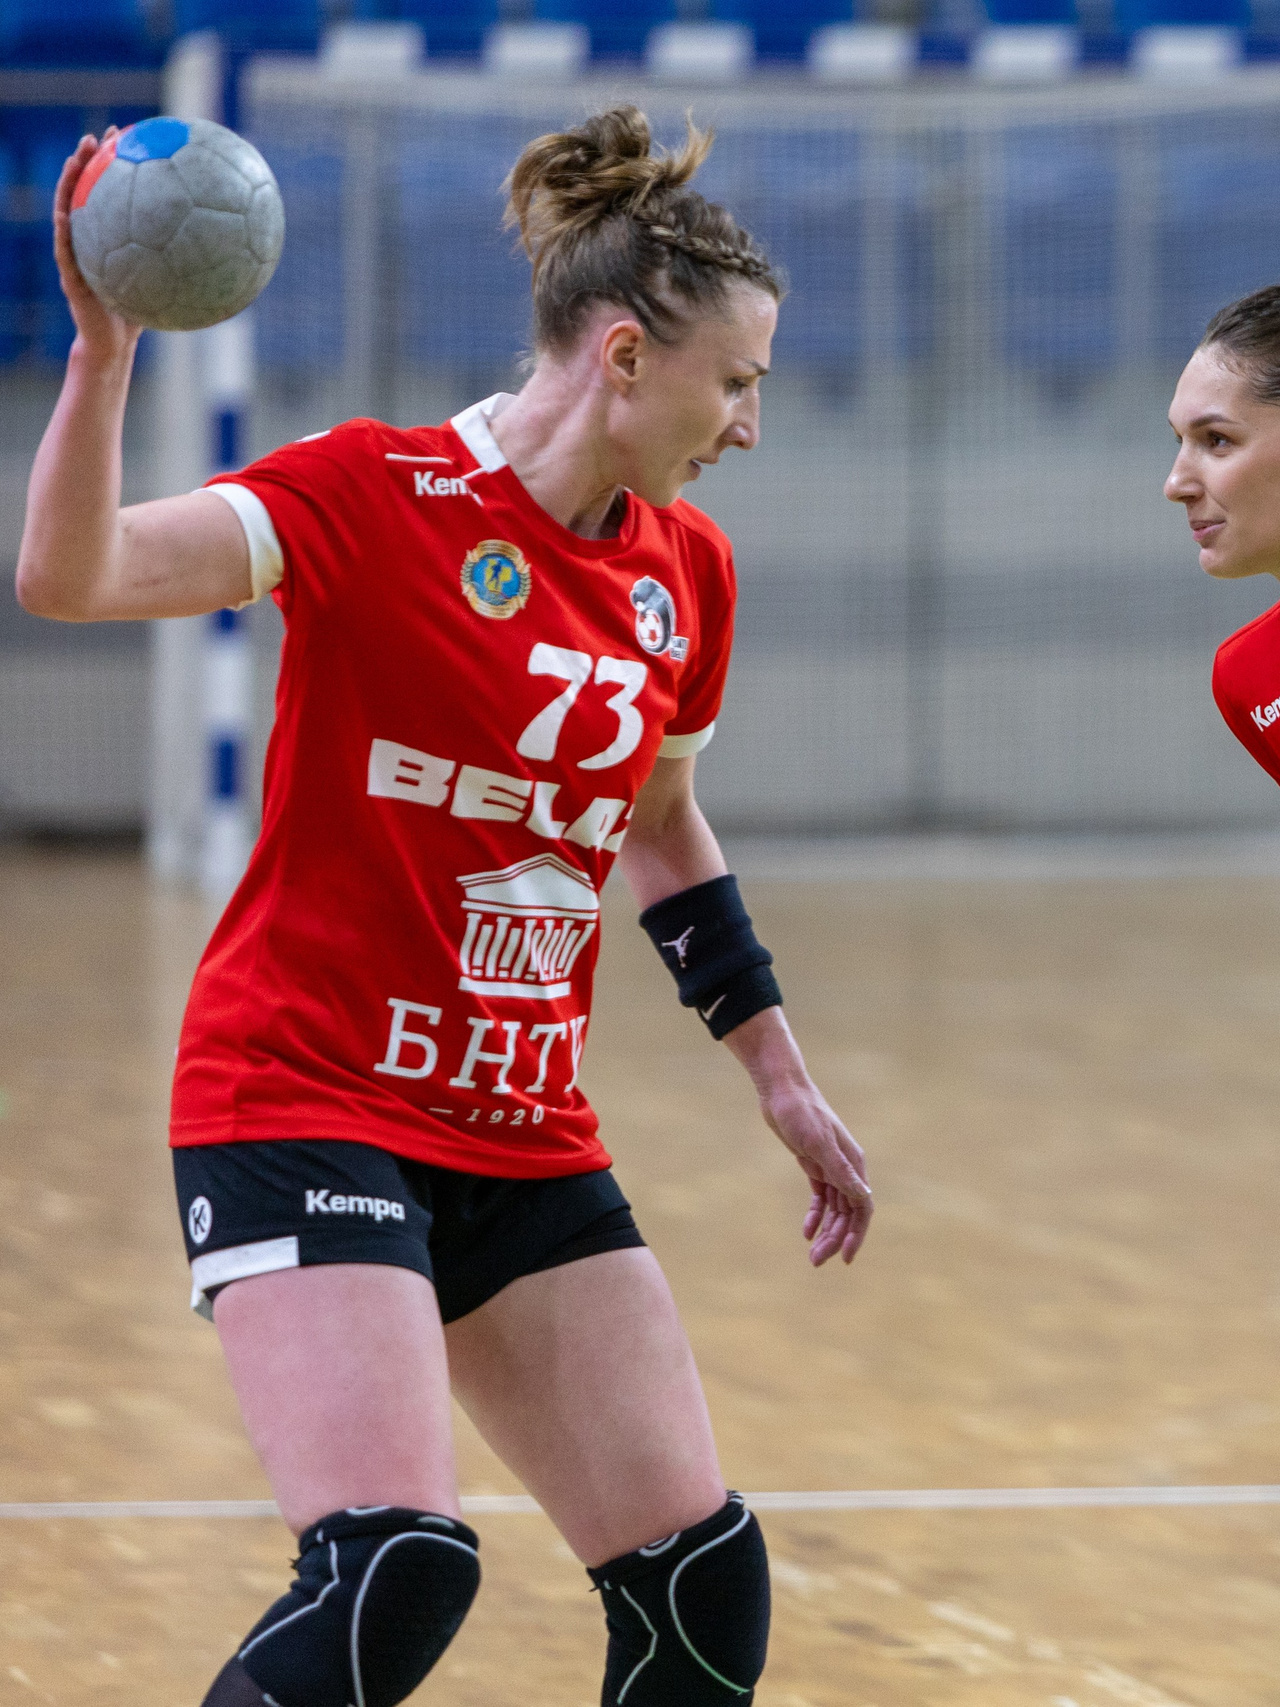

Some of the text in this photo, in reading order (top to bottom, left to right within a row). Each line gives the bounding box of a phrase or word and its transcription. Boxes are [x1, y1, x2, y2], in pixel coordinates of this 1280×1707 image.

[516, 642, 647, 770] 73
[366, 737, 635, 854] BELA
[304, 1188, 406, 1224] Kempa
